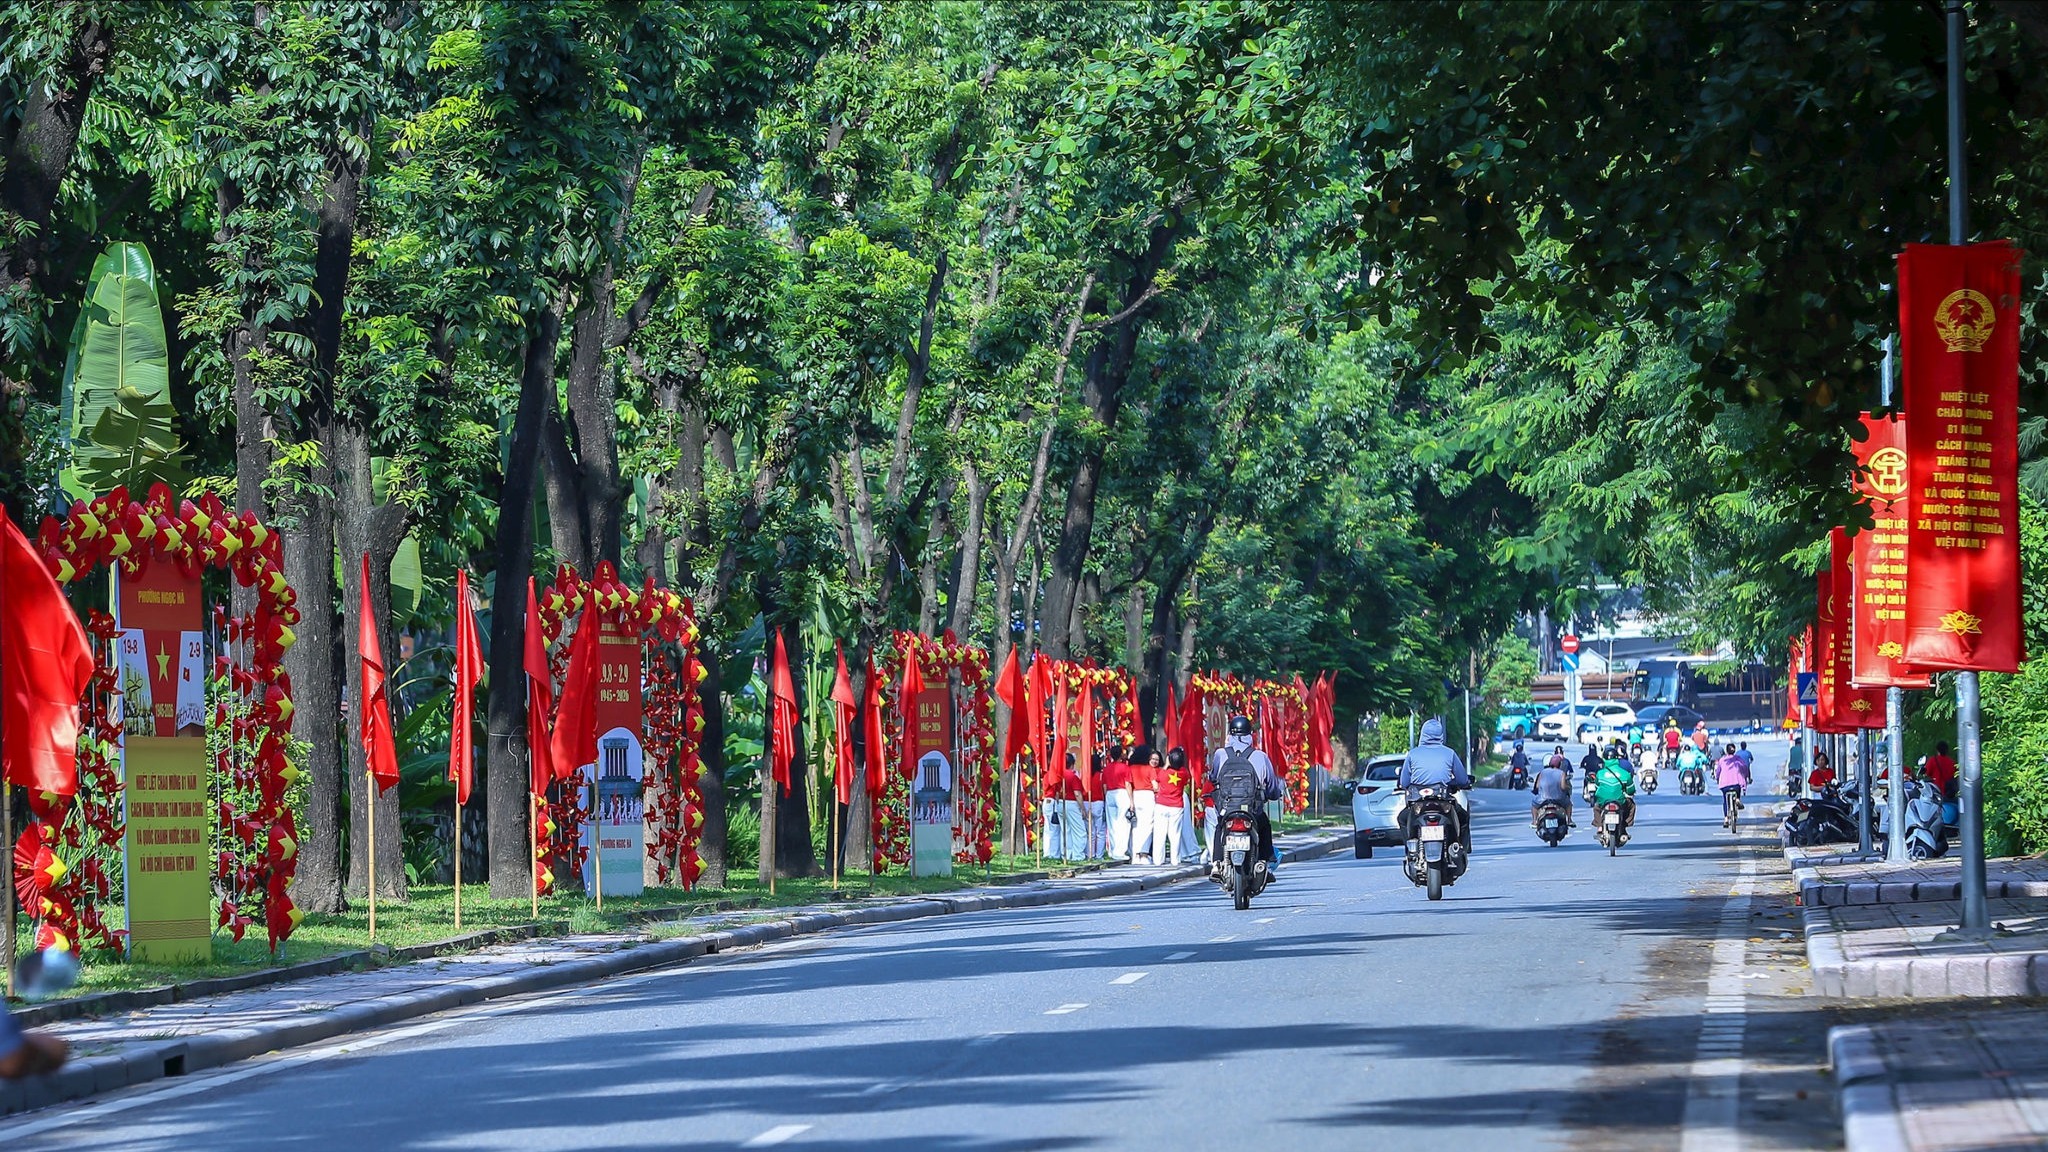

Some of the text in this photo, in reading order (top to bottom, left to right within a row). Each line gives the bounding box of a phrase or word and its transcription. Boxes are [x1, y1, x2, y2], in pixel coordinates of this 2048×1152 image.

[1941, 391, 1989, 405] NHIỆT LIỆT
[1937, 406, 1963, 418] CHÀO
[1947, 424, 1958, 434] 81
[1936, 438, 1962, 450] CÁCH
[1936, 455, 1968, 466] THÁNG
[1932, 471, 1993, 485] THÀNH CÔNG
[1924, 486, 2001, 501] VÀ QUỐC KHÁNH
[1922, 503, 2000, 518] NƯỚC CỘNG HÒA
[1917, 518, 2005, 535] XÃ HỘI CHỦ NGHĨA
[1935, 535, 1956, 549] VIỆT
[1957, 538, 1980, 548] NAM
[123, 639, 138, 655] 19-8
[189, 642, 201, 658] 2-9
[600, 663, 613, 683] 9.8
